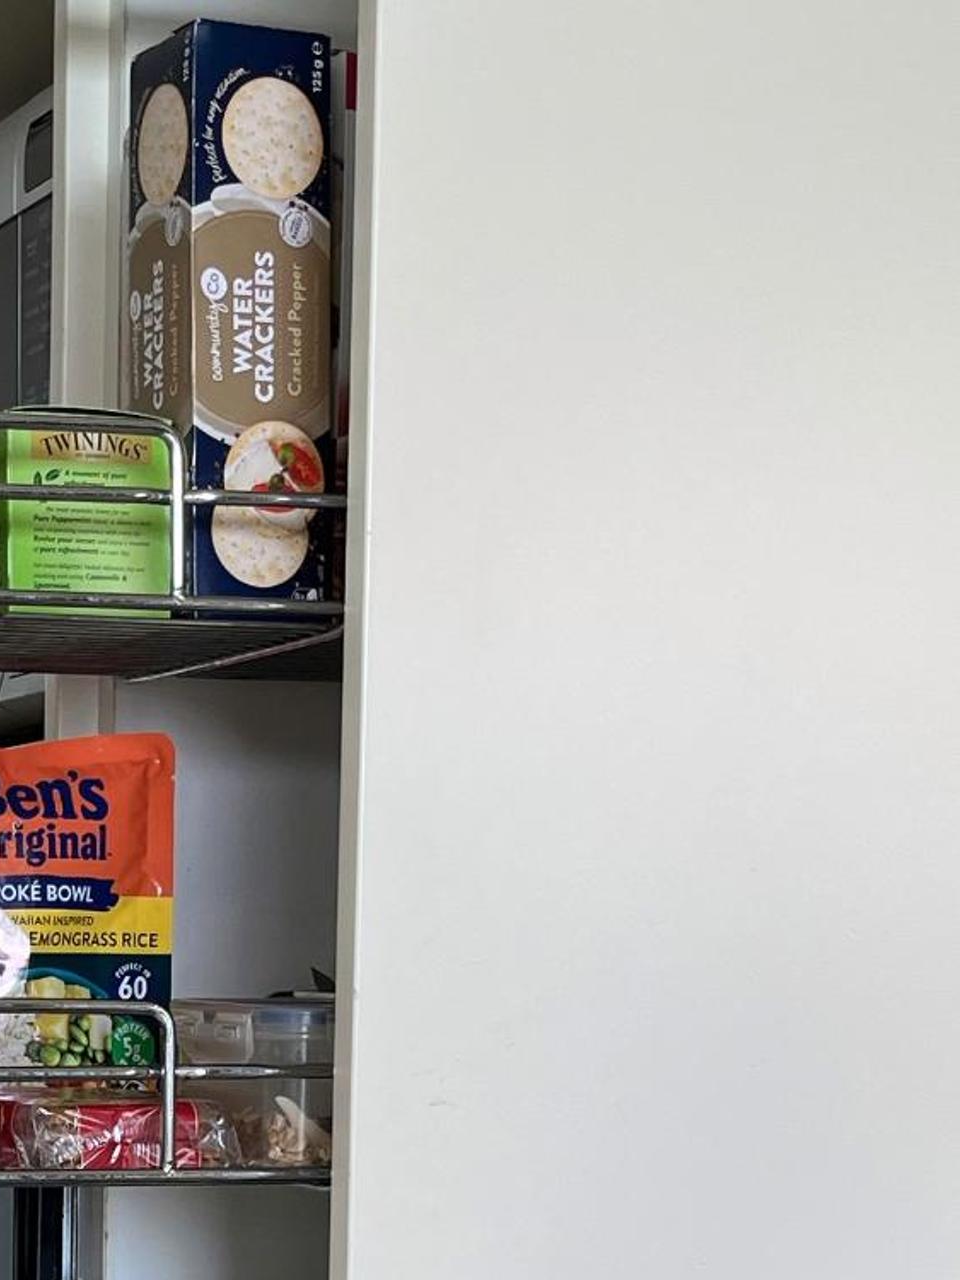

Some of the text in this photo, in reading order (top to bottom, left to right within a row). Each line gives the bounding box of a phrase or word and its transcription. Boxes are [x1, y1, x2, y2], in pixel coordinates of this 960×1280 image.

[287, 264, 307, 322] Pepper
[144, 293, 154, 387] WATER
[152, 259, 164, 410] CRACKERS
[206, 300, 229, 381] community
[233, 278, 254, 373] WATER
[255, 251, 275, 403] CRACKERS
[287, 327, 302, 396] Cracked
[41, 431, 144, 460] TWININGS
[46, 884, 94, 903] BOWL
[52, 915, 95, 926] INSPIRED
[29, 931, 118, 948] EMONGRASS
[121, 933, 159, 948] RICE
[118, 975, 148, 1000] 60
